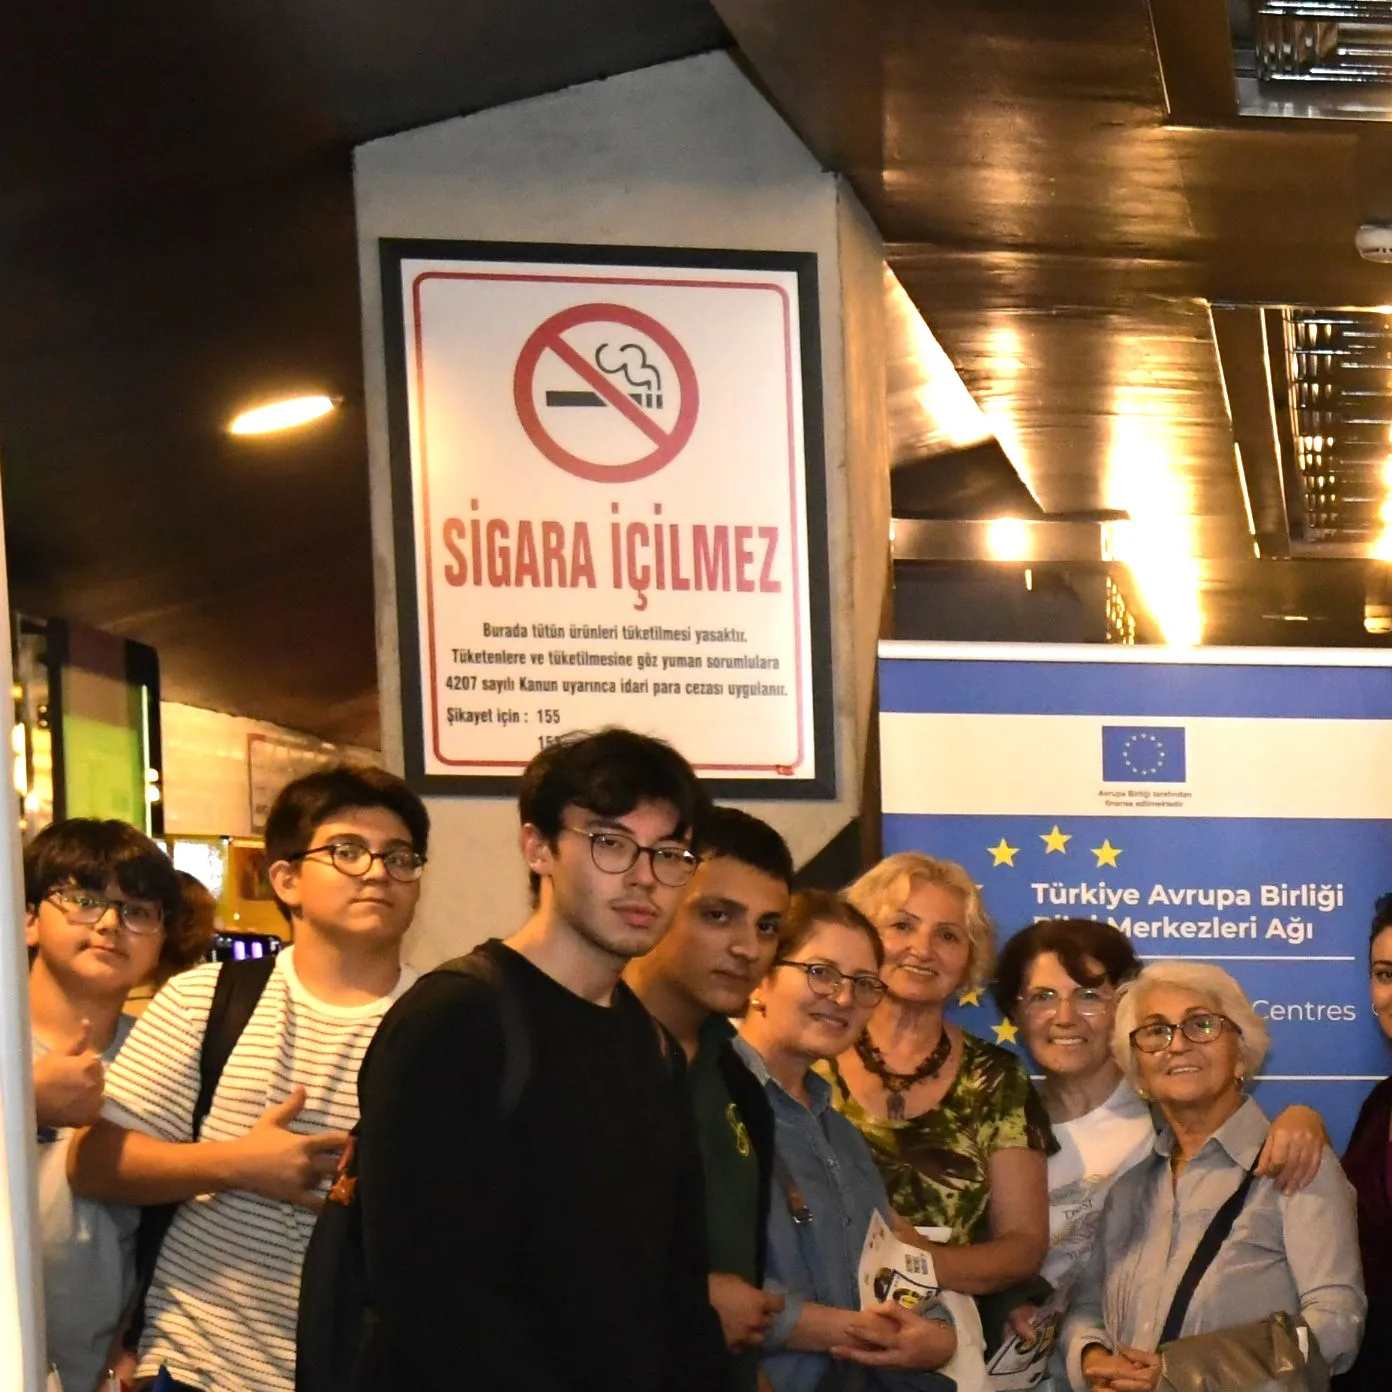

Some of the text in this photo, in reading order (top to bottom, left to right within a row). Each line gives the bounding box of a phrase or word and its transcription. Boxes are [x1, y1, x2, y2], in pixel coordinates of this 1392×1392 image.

[443, 498, 782, 611] SİGARA İÇİLMEZ
[482, 622, 748, 644] Burada tütün ürünleri tüketilmesi yasaktır.
[451, 648, 780, 671] Tüketenlere ve tüketilmesine göz yuman sorumlulara
[445, 675, 789, 699] 4207 sayılı Kanun uyarınca idari para cezası uygulanır.
[446, 707, 493, 726] Şikayet
[497, 708, 520, 728] için
[537, 708, 560, 724] 155
[1031, 882, 1344, 912] Türkiye Avrupa Birliği
[1111, 916, 1257, 940] Merkezleri
[1265, 916, 1313, 945] Ağı
[1252, 999, 1357, 1022] Centres
